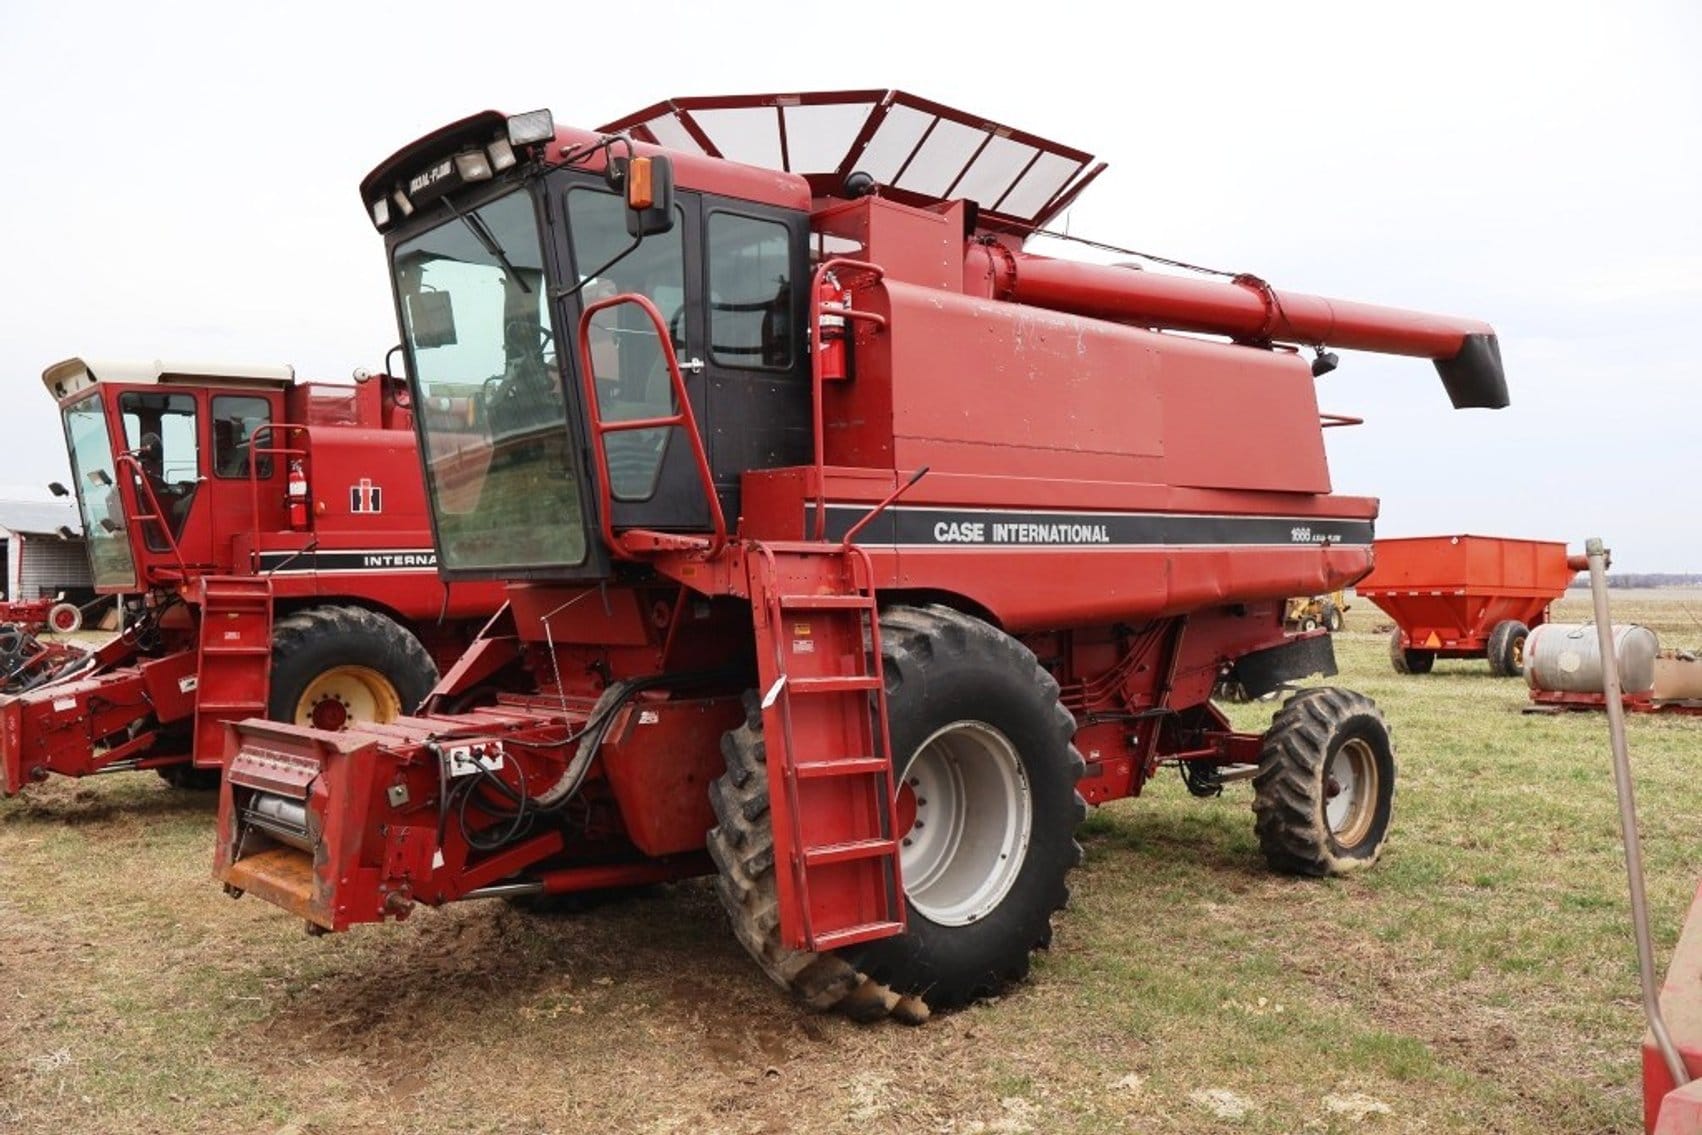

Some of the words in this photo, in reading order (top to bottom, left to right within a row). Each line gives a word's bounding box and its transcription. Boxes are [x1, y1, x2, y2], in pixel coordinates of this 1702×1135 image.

[933, 521, 985, 543] CASE
[992, 523, 1110, 543] INTERNATIONAL
[363, 555, 437, 567] INTERNA
